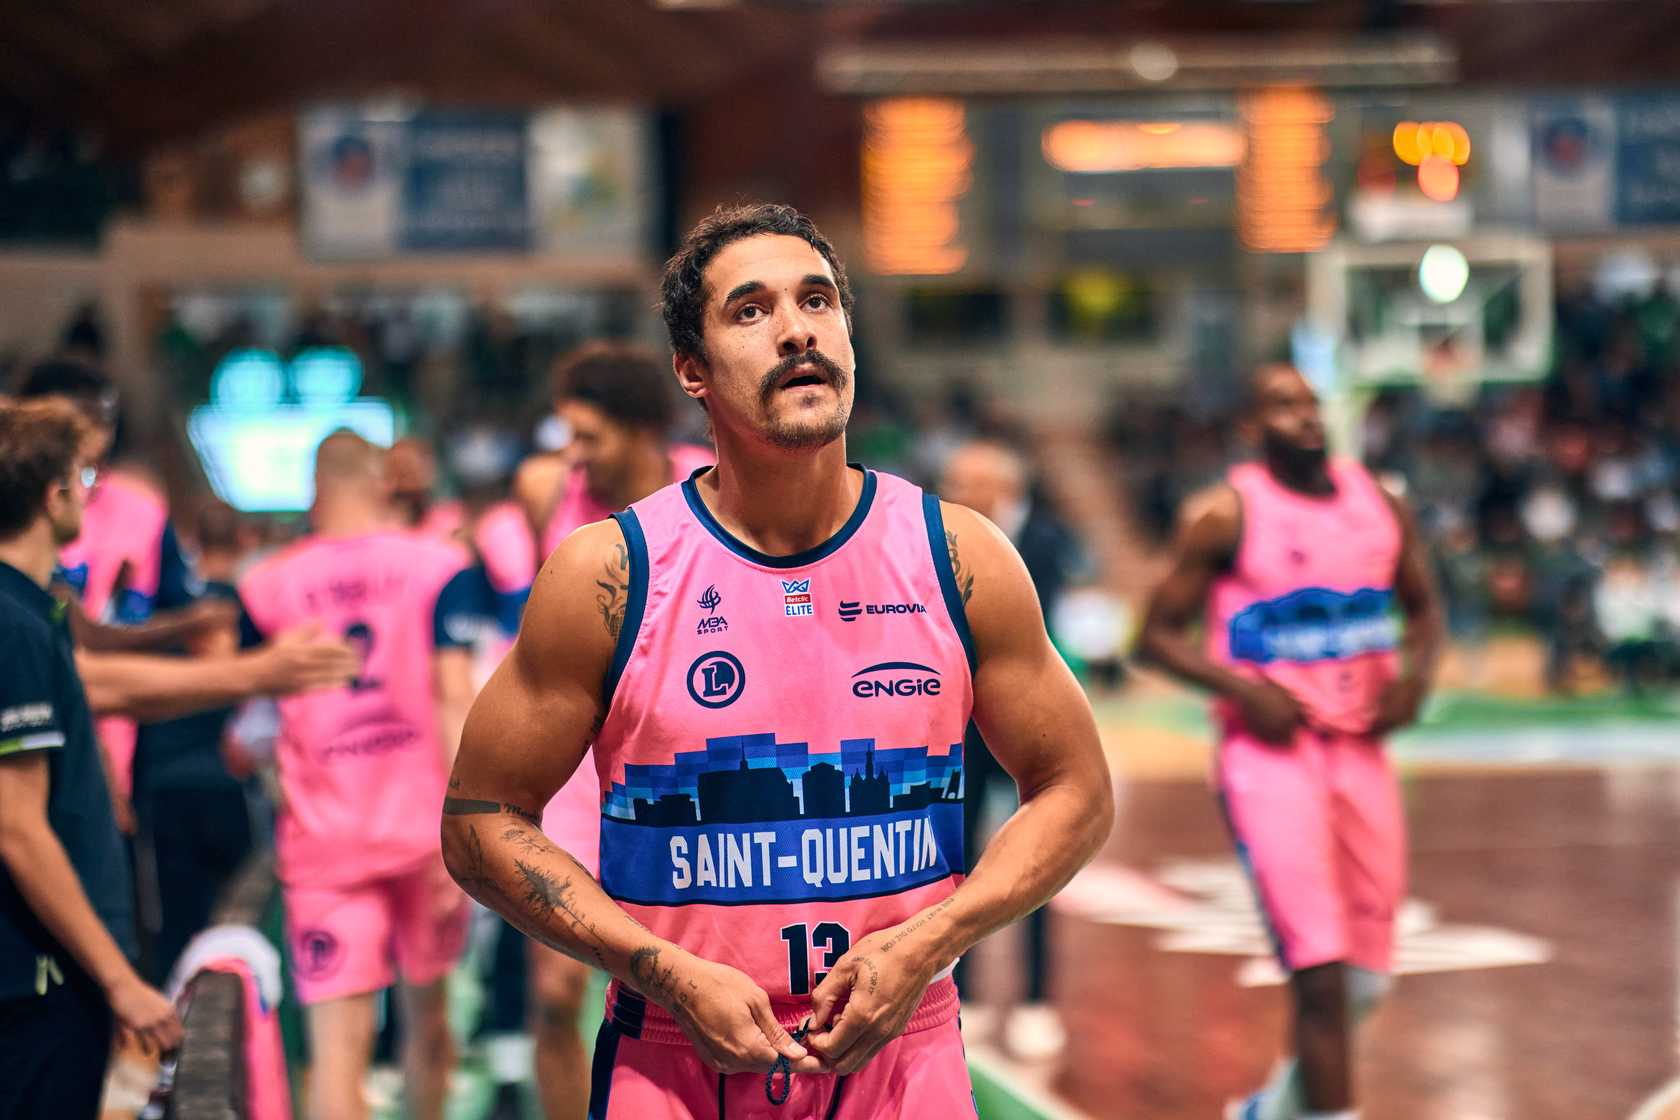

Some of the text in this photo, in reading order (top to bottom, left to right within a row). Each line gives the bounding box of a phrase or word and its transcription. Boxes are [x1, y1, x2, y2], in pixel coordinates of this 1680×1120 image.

[697, 625, 729, 635] SPORT
[866, 604, 927, 615] EUROVIA
[669, 816, 937, 889] SAINT-QUENTIN
[780, 922, 851, 996] 13
